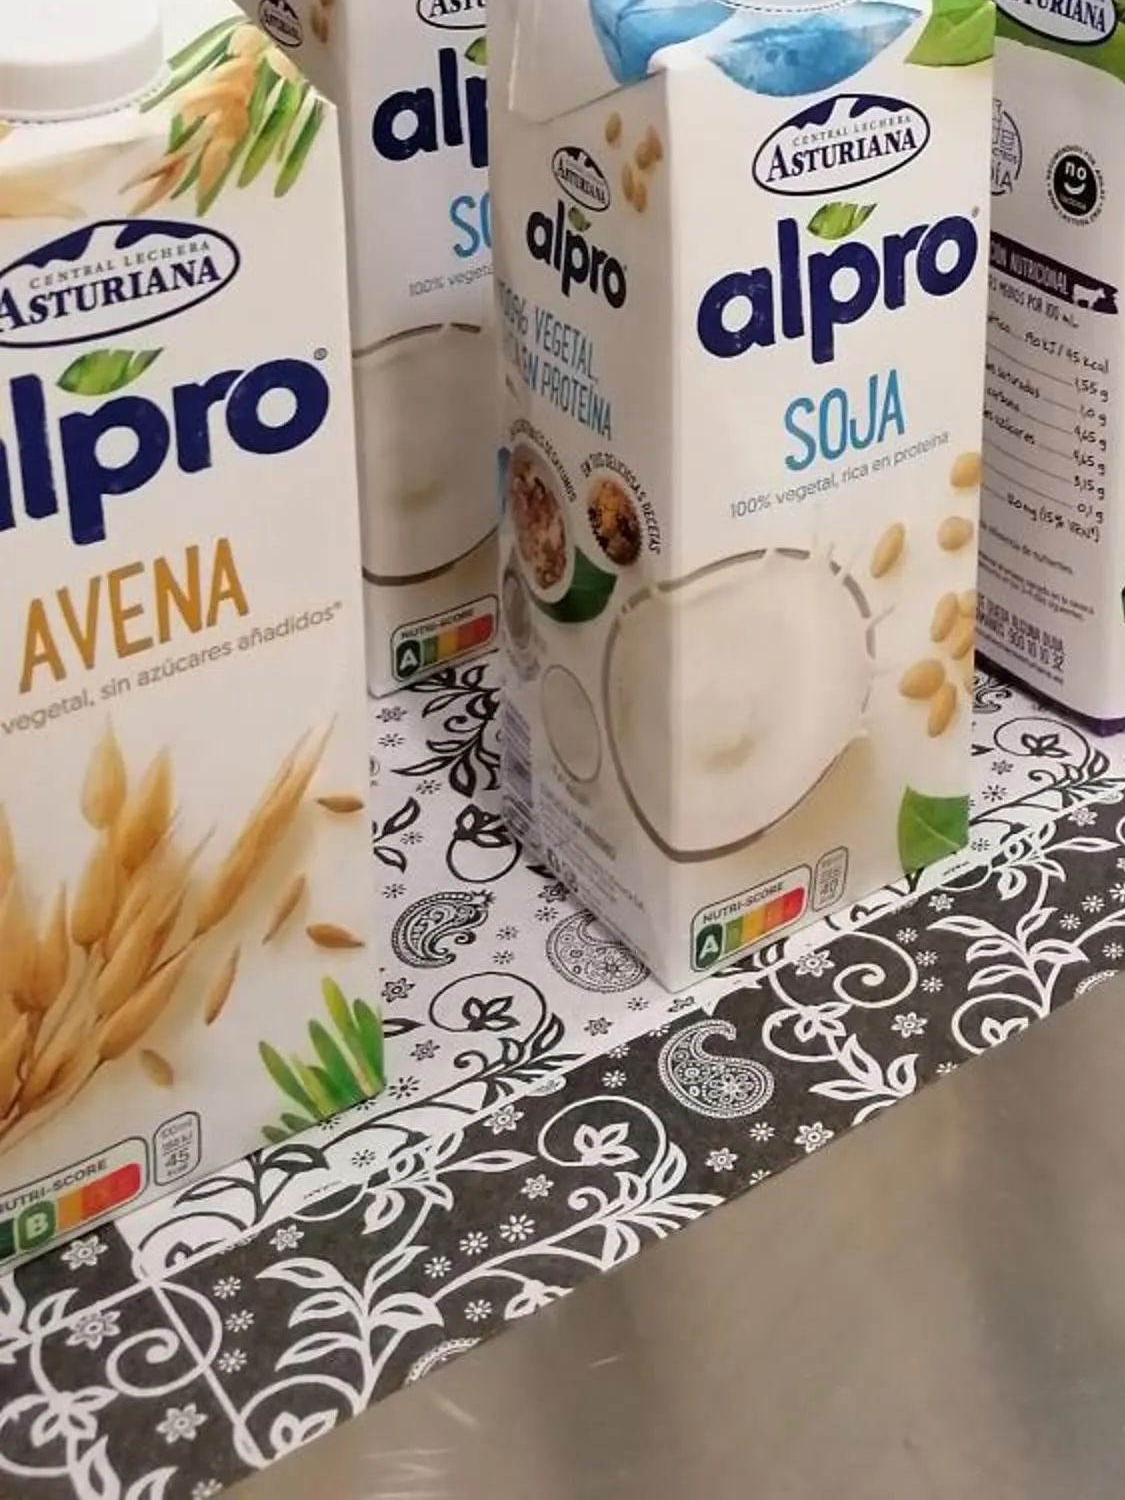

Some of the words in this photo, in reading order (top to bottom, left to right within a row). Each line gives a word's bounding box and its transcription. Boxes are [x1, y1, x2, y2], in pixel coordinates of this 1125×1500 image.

[765, 127, 918, 184] ASTURIANA
[792, 121, 852, 147] CENTRAL
[853, 113, 913, 137] LECHERA
[1064, 160, 1087, 181] no
[28, 257, 117, 290] CENTRAL
[122, 239, 212, 271] LECHERA
[526, 198, 627, 309] alpro
[0, 254, 222, 336] ASTURIANA
[696, 215, 979, 365] alpro
[541, 361, 613, 442] PROTEÍNA
[783, 368, 906, 472] SOJA
[0, 356, 332, 546] lpro
[730, 489, 773, 519] 100%
[775, 464, 841, 505] vegetal,
[841, 457, 869, 485] rica
[870, 453, 892, 474] en
[892, 430, 951, 472] proteína
[19, 536, 250, 695] AVENA
[0, 688, 97, 737] vegetal,
[100, 673, 132, 702] sin
[136, 636, 233, 690] azúcares
[399, 646, 418, 669] A
[703, 880, 785, 924] NUTRI-SCORE
[699, 933, 720, 960] A
[0, 1158, 109, 1214] UTRI-SCORE
[25, 1212, 50, 1239] B
